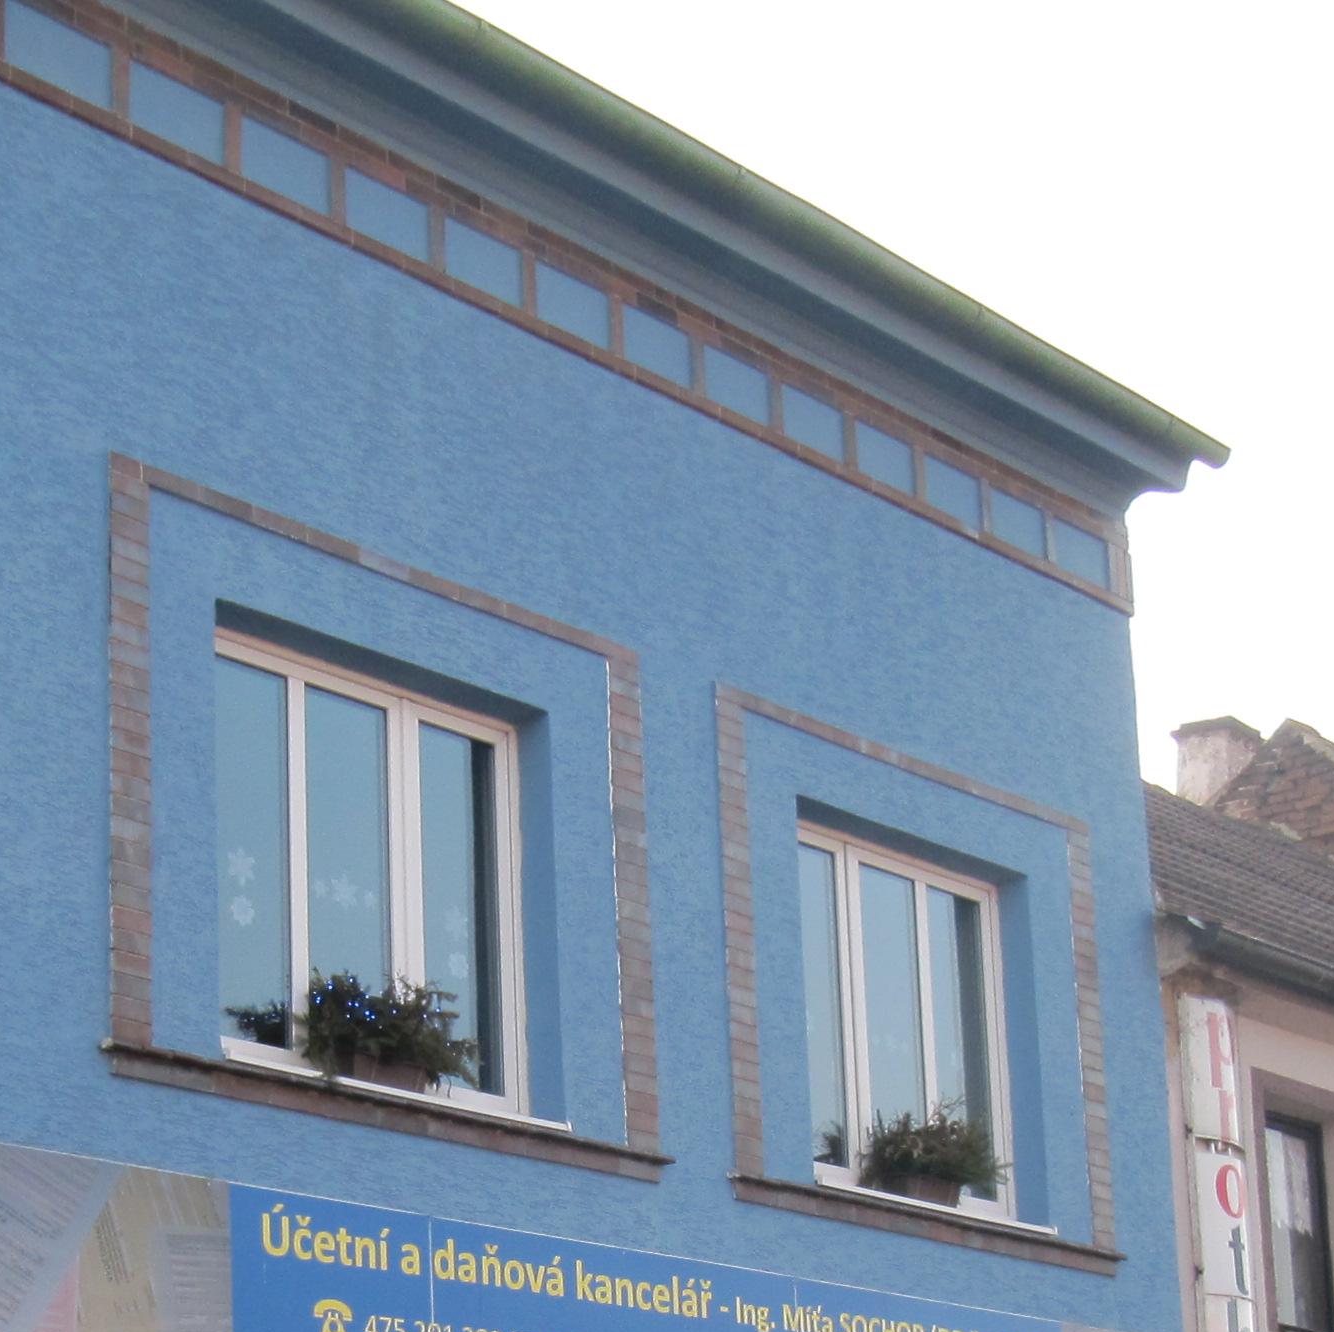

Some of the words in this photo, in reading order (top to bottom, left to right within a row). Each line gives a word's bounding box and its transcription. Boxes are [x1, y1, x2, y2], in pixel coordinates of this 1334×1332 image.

[261, 1203, 391, 1271] Účetní
[400, 1242, 421, 1276] a
[433, 1238, 565, 1297] daňová
[575, 1259, 713, 1319] kancelář
